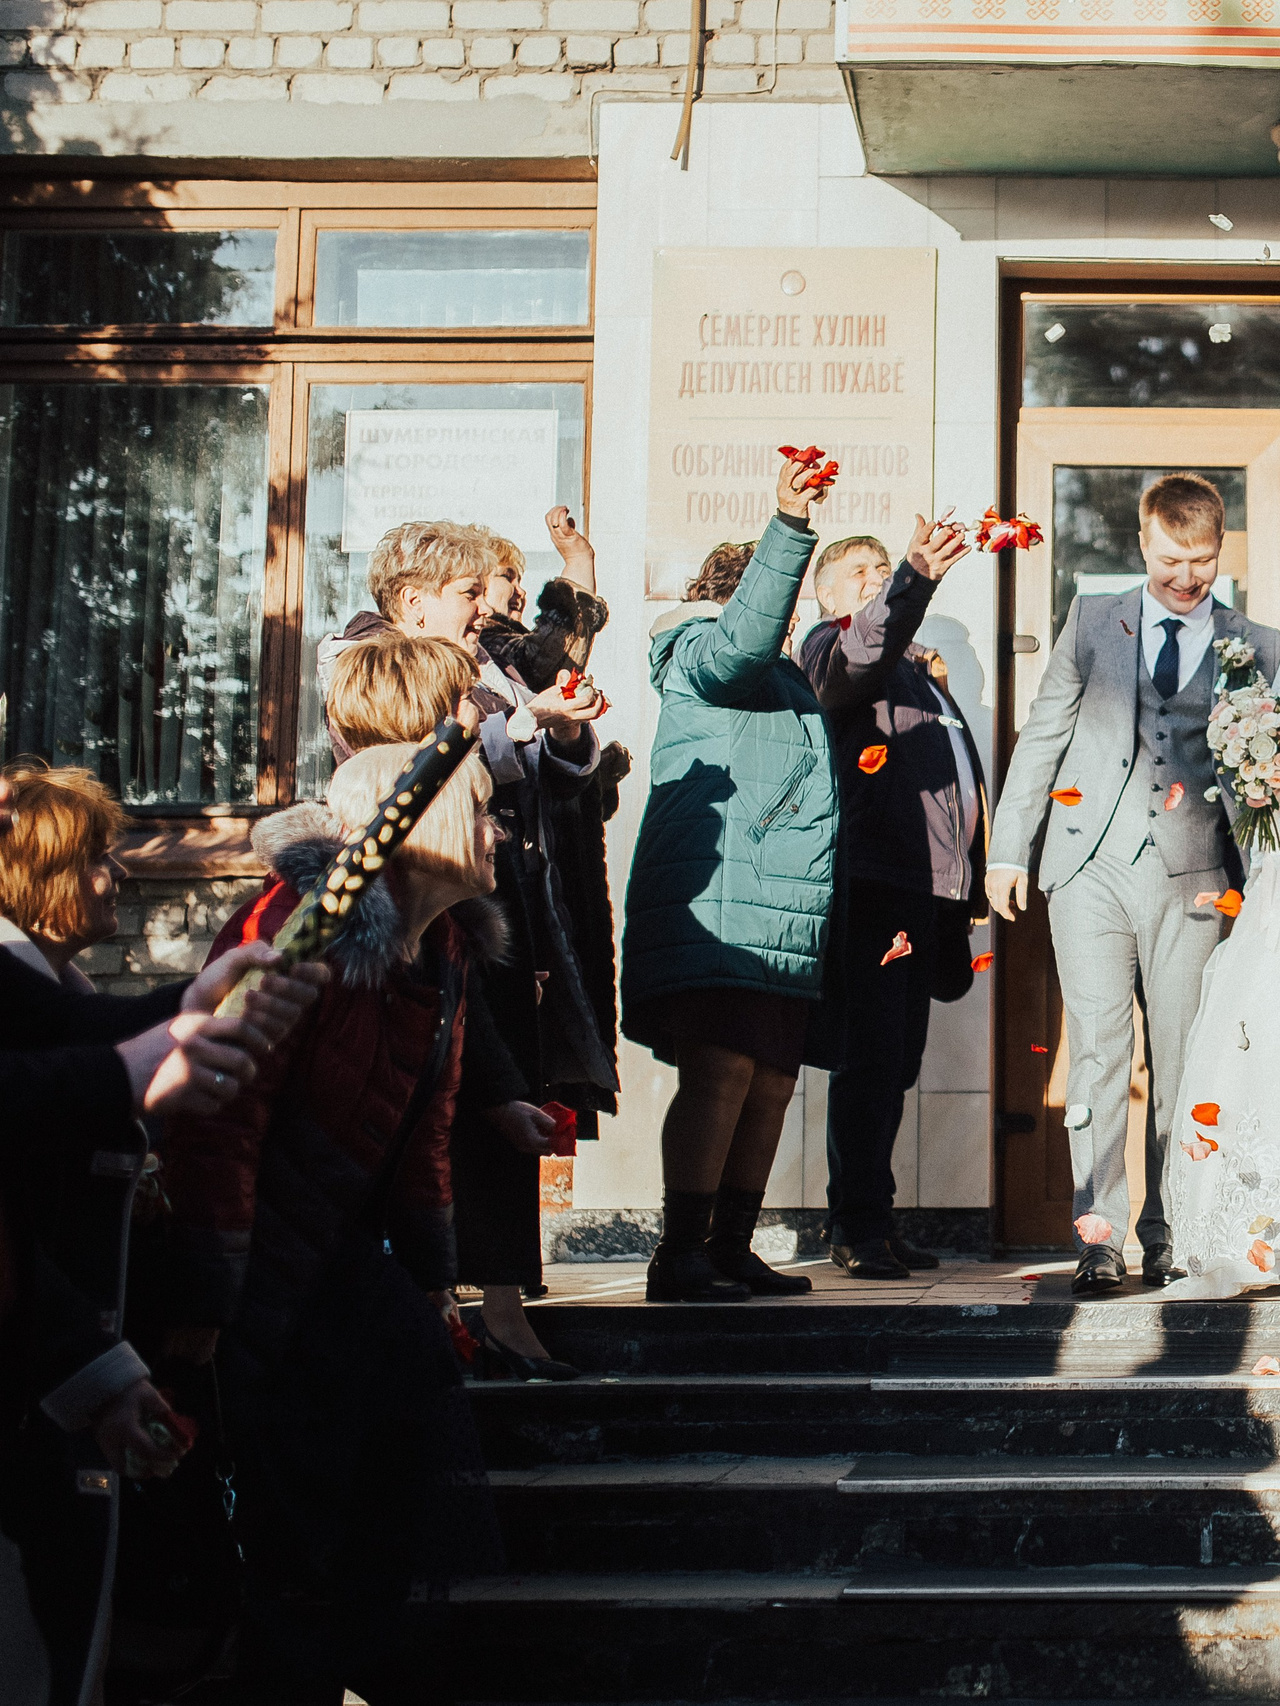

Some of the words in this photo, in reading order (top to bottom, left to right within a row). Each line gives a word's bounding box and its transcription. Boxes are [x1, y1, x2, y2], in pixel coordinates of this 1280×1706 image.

[812, 314, 887, 347] ХУЛИН
[678, 361, 812, 398] ДЕПУТАТСЕН
[358, 427, 546, 444] ШУМЕРЛИНСКАЯ
[671, 443, 779, 478] СОБРАНИЕ
[686, 491, 771, 528] ГОРОДА
[798, 491, 891, 525] МЕРЛЯ
